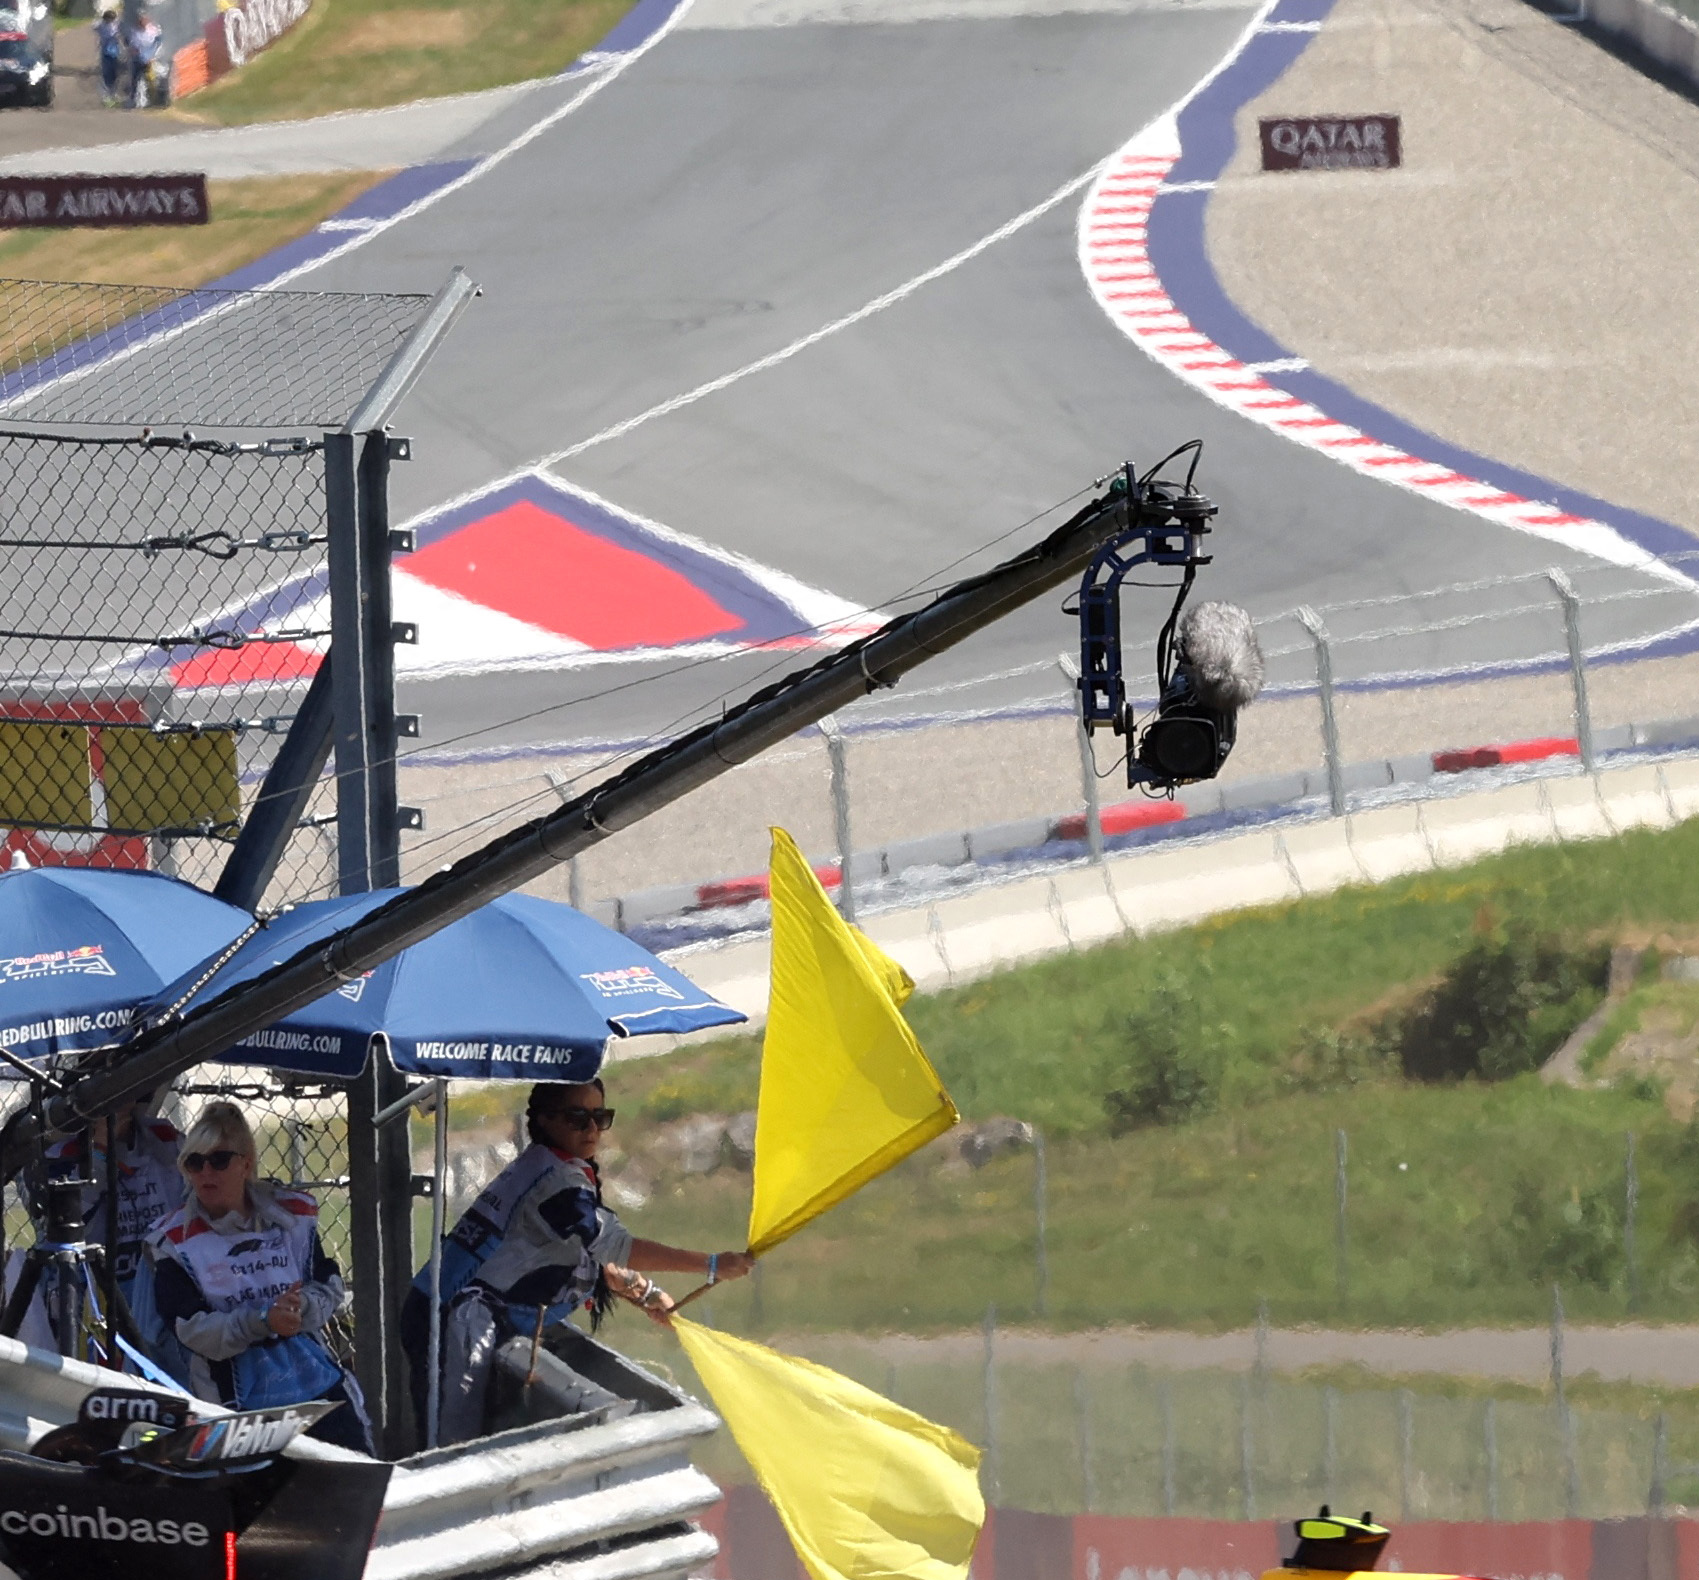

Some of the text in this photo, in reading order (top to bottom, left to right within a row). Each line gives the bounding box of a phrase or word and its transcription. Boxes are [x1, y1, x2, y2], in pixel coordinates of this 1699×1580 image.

[1271, 121, 1387, 155] QATAR
[56, 187, 200, 217] AIRWAYS
[416, 1042, 573, 1065] WELCOME RACE FANS
[86, 1396, 159, 1421] arm
[0, 1505, 210, 1547] coinbase
